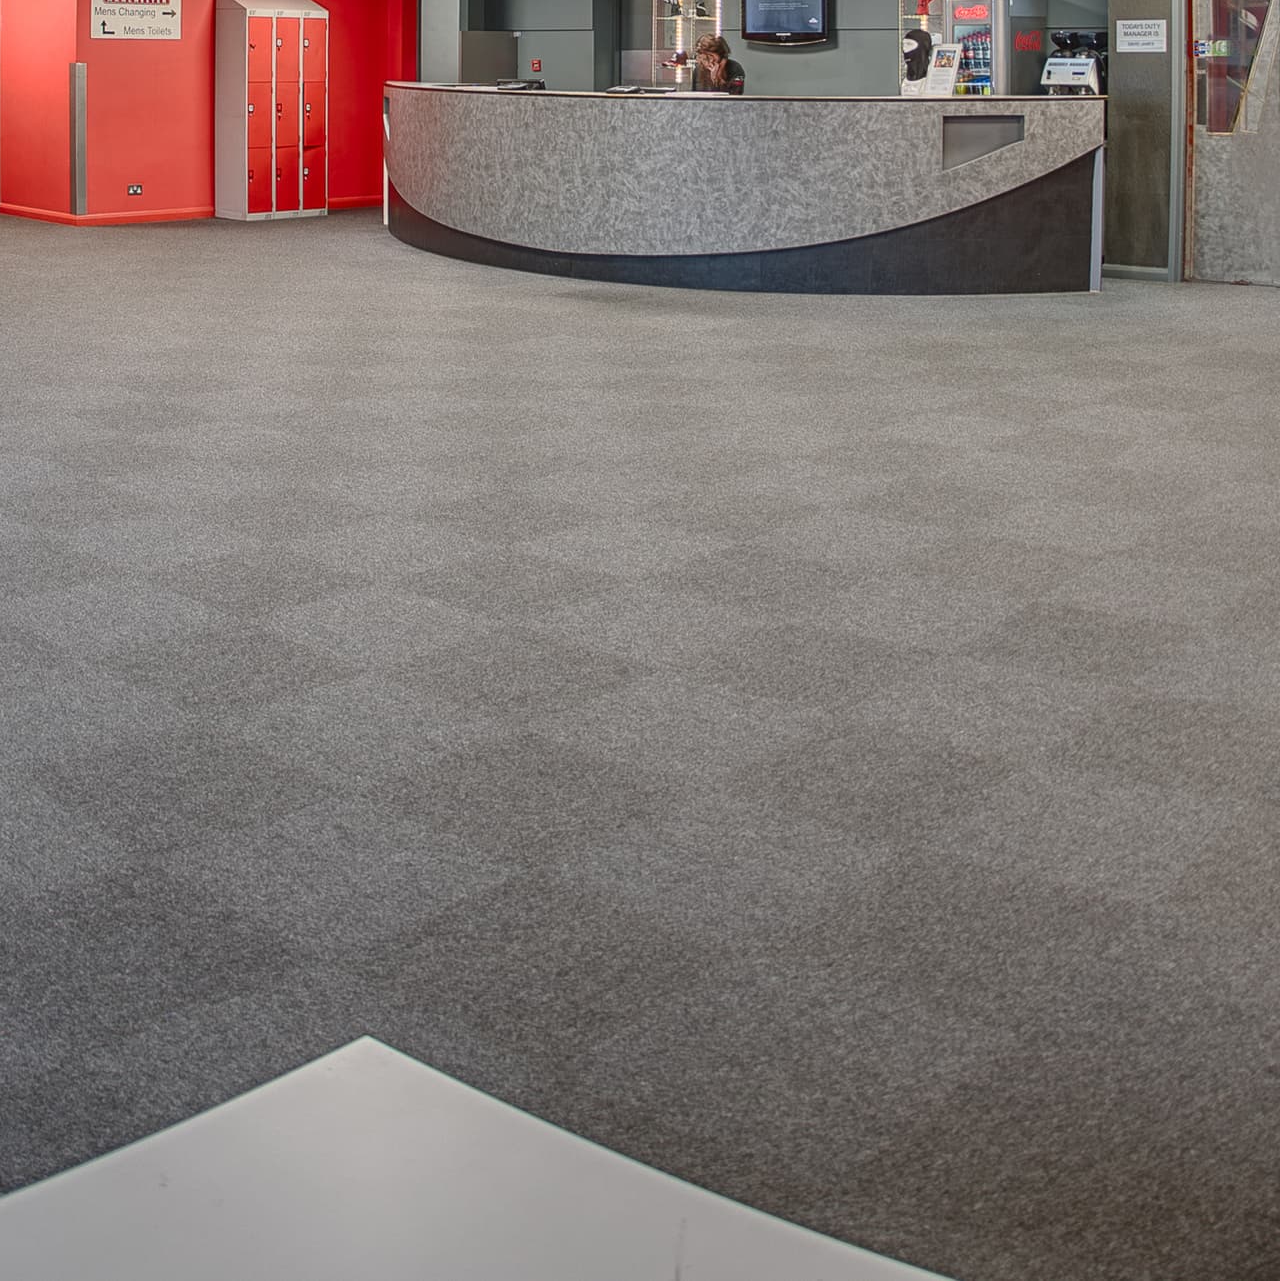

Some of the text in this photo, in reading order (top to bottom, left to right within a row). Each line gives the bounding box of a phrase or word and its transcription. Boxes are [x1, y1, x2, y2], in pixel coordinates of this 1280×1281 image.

[94, 6, 156, 18] Mens Changing
[123, 25, 172, 36] Mens Toilets
